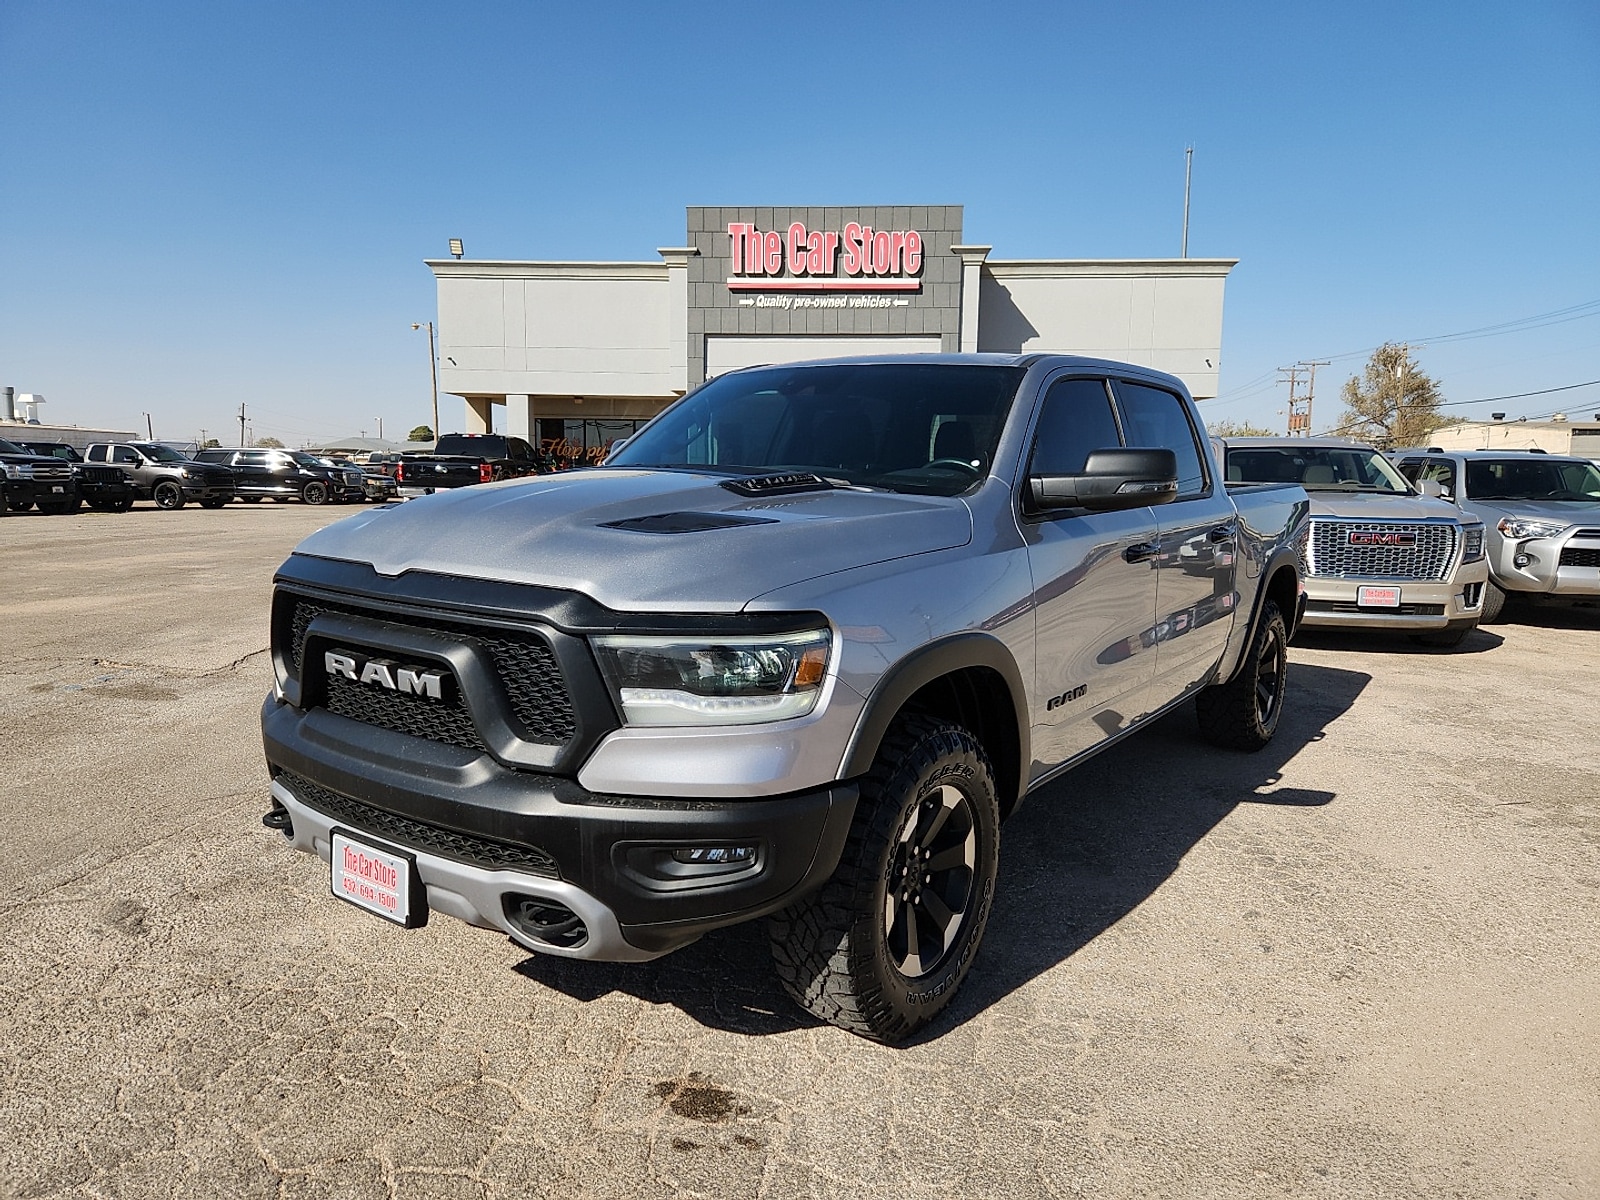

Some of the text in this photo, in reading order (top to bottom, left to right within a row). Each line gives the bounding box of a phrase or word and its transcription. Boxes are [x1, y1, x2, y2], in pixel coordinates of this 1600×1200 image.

[728, 221, 923, 275] The Car Store
[756, 295, 891, 310] Quality pre-owned vehicles
[1350, 532, 1415, 545] GMC
[325, 650, 442, 699] RAM
[1047, 683, 1088, 711] RAM
[343, 845, 358, 872] The
[359, 853, 373, 878] Car
[374, 859, 396, 888] Store
